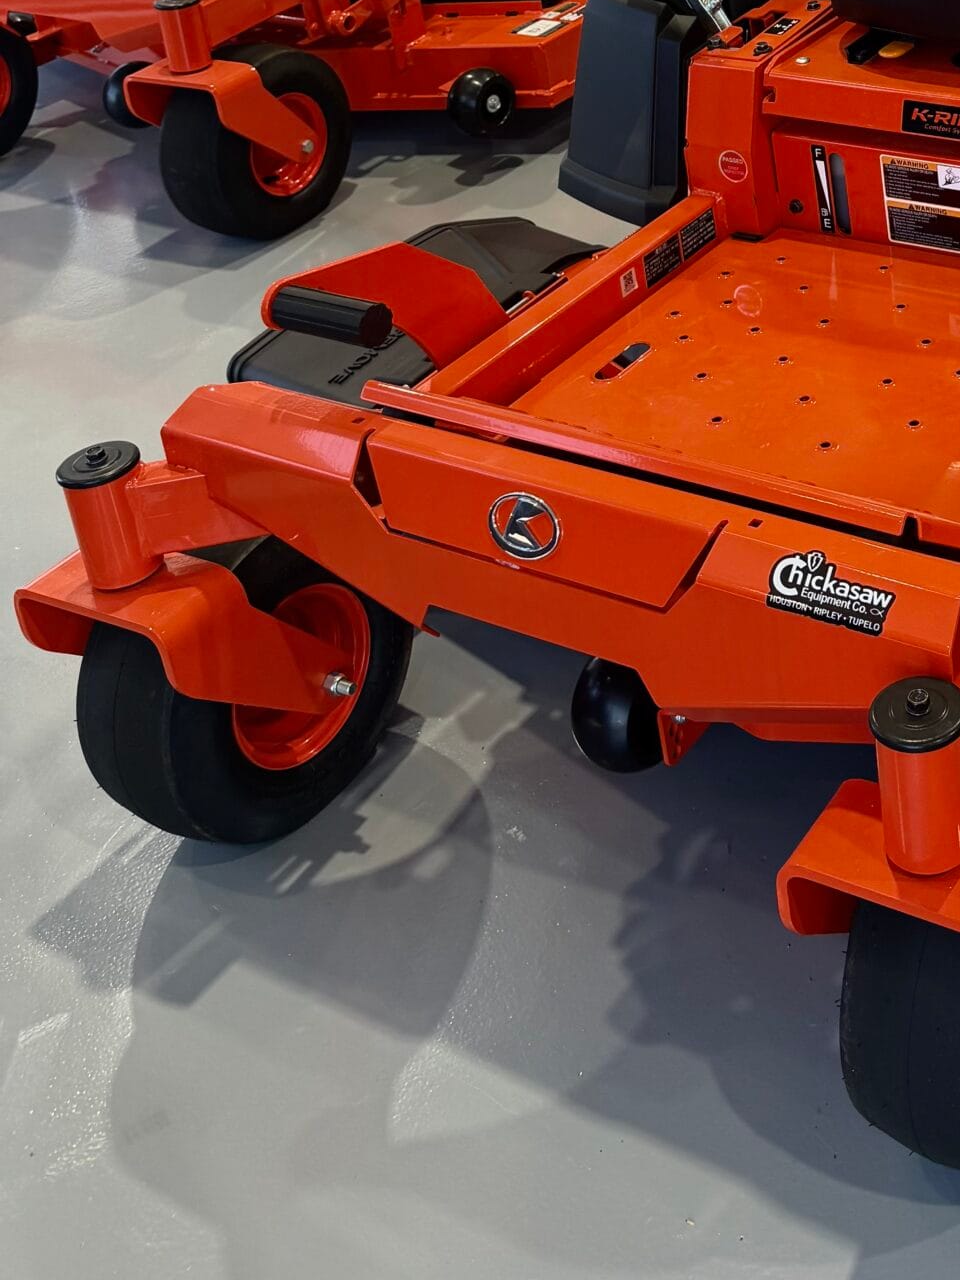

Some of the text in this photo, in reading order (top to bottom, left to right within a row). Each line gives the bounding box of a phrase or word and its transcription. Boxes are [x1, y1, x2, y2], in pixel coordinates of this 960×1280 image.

[924, 122, 951, 133] Comfort
[815, 148, 822, 157] F
[896, 159, 929, 170] WARNING
[915, 205, 948, 216] WARNING
[823, 218, 832, 228] E
[773, 555, 892, 608] Chickasaw
[801, 587, 868, 615] Equipment Co.
[769, 595, 881, 632] HOUSTON RIPLEY TUPELO
